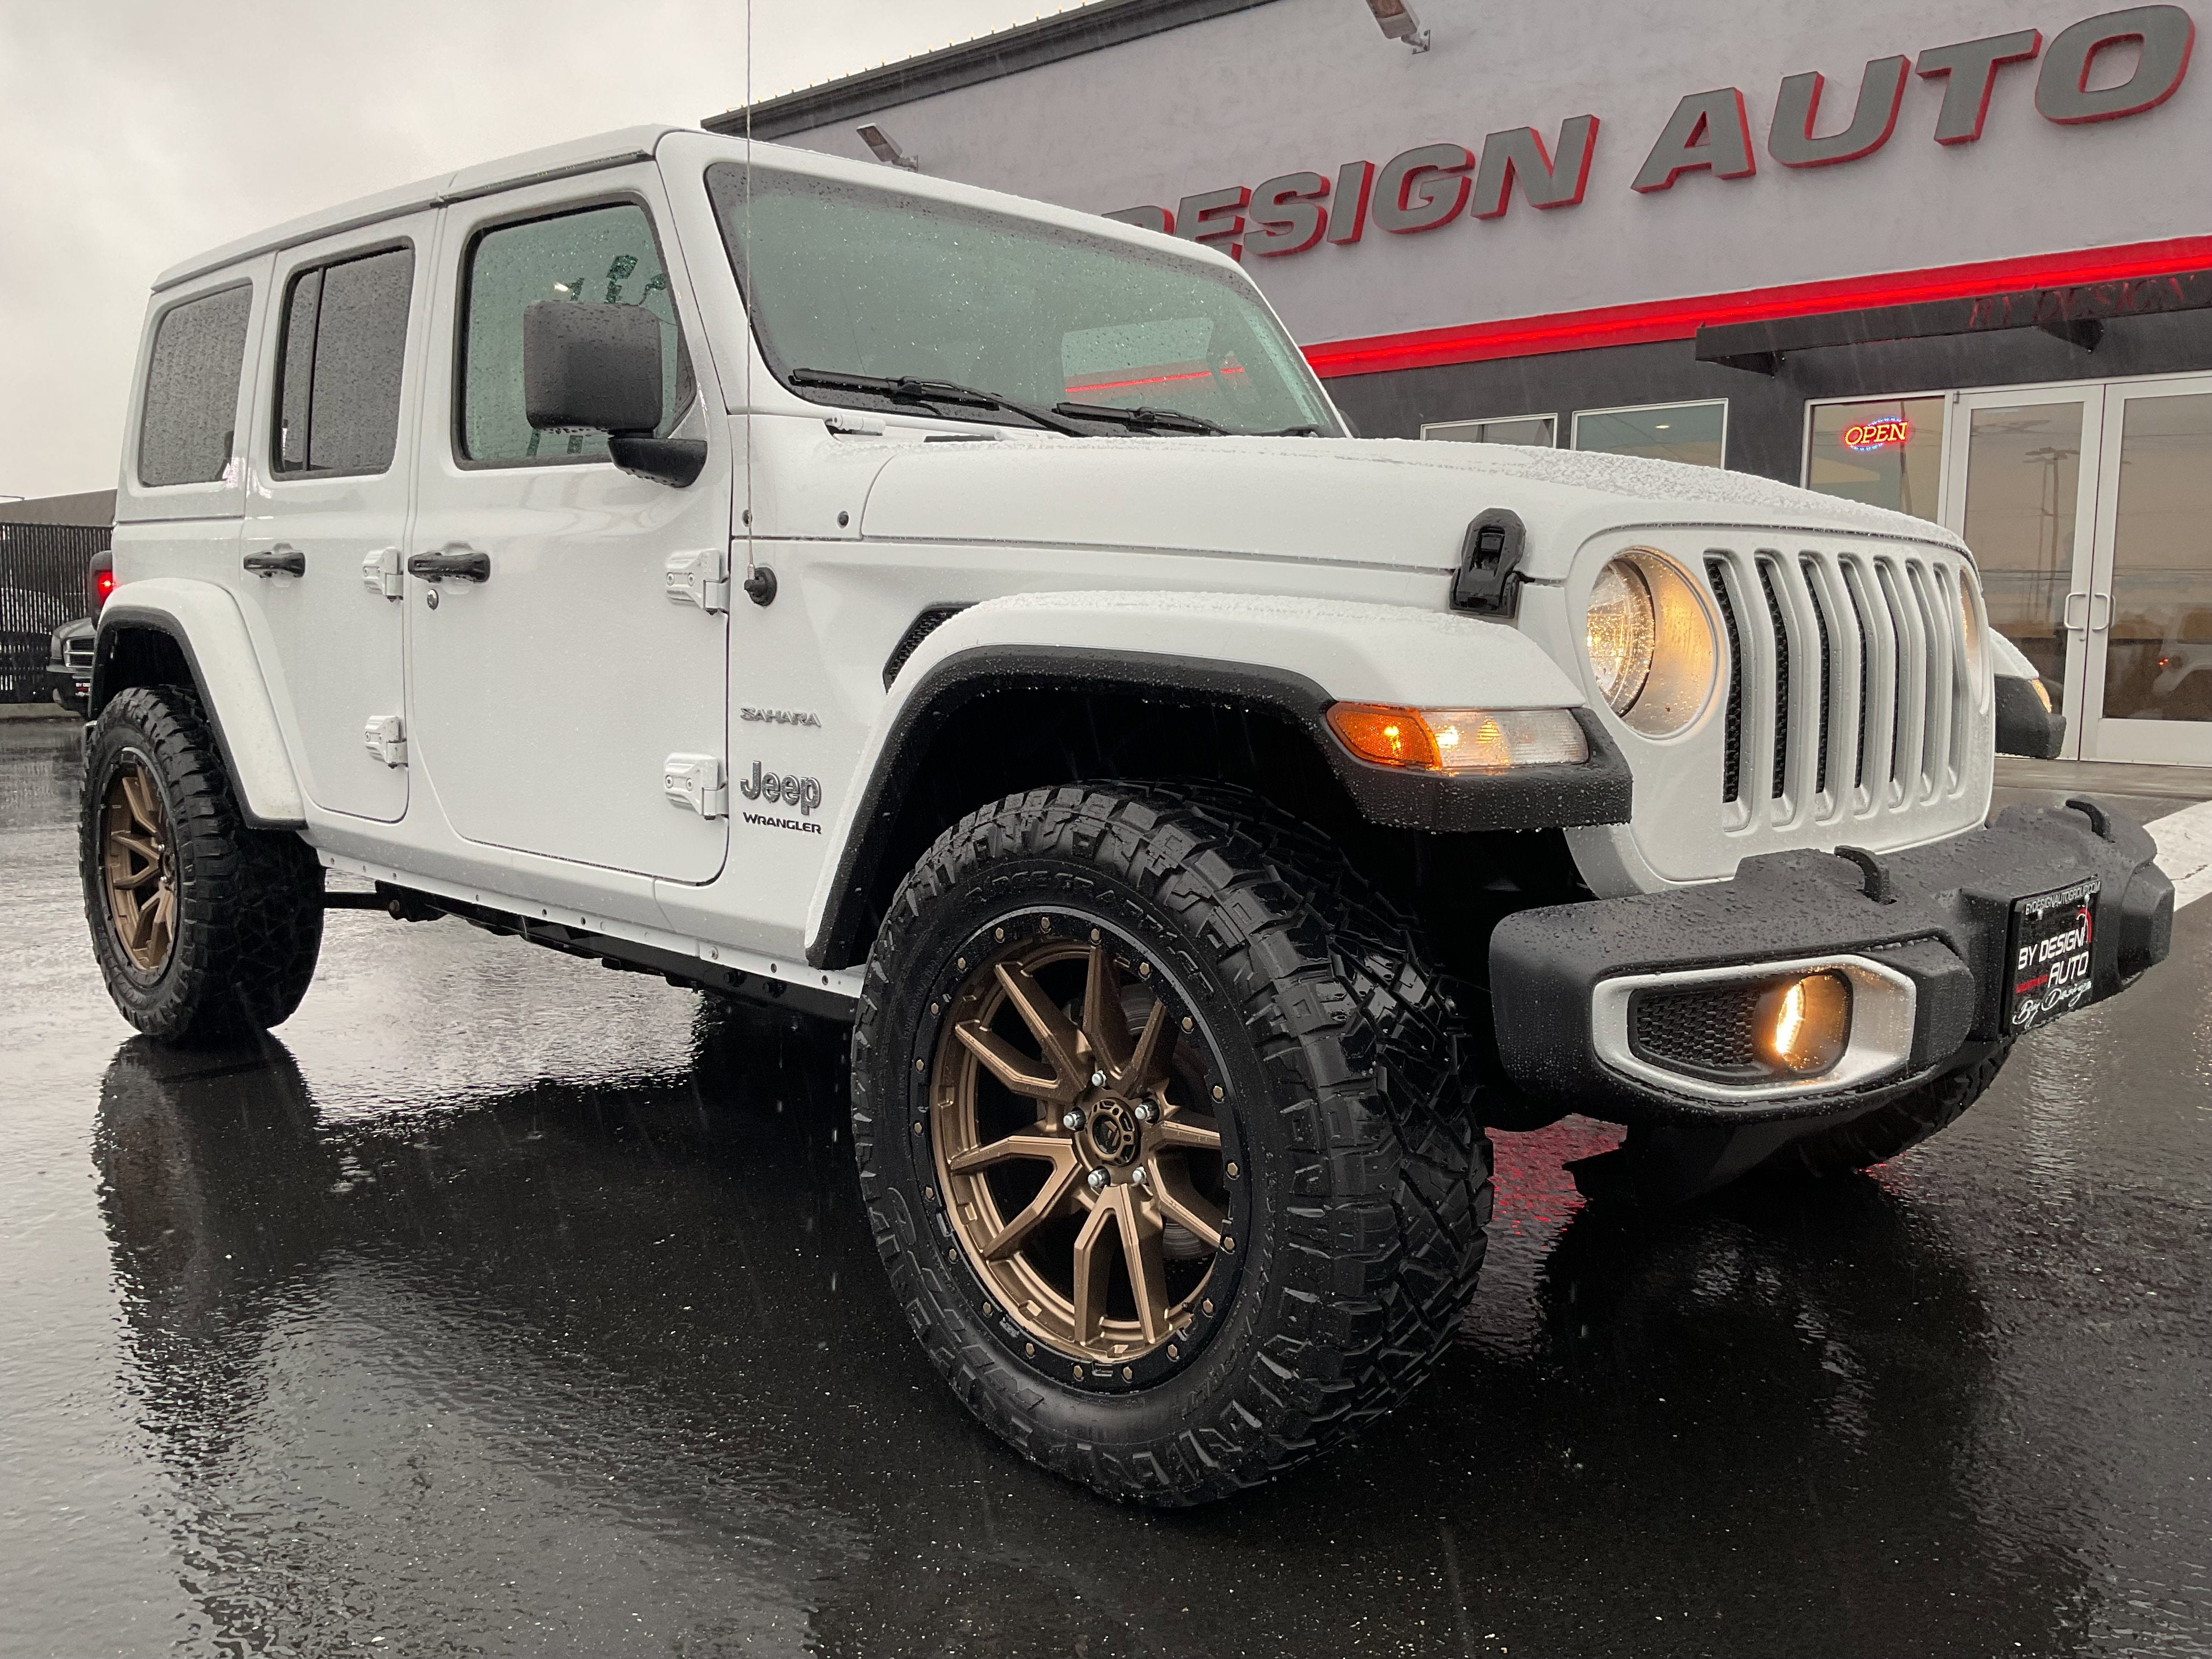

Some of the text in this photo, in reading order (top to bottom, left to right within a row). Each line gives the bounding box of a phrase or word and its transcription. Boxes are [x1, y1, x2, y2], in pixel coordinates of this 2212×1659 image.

[1630, 4, 2196, 194] AUTO
[1844, 421, 1908, 445] OPEN
[740, 707, 821, 728] SAHARA
[741, 760, 821, 816] Jeep
[743, 812, 822, 834] WRANGLER
[2018, 927, 2085, 970] BY DESIGN
[2047, 951, 2089, 988] AUTO
[2012, 1000, 2040, 1030] By
